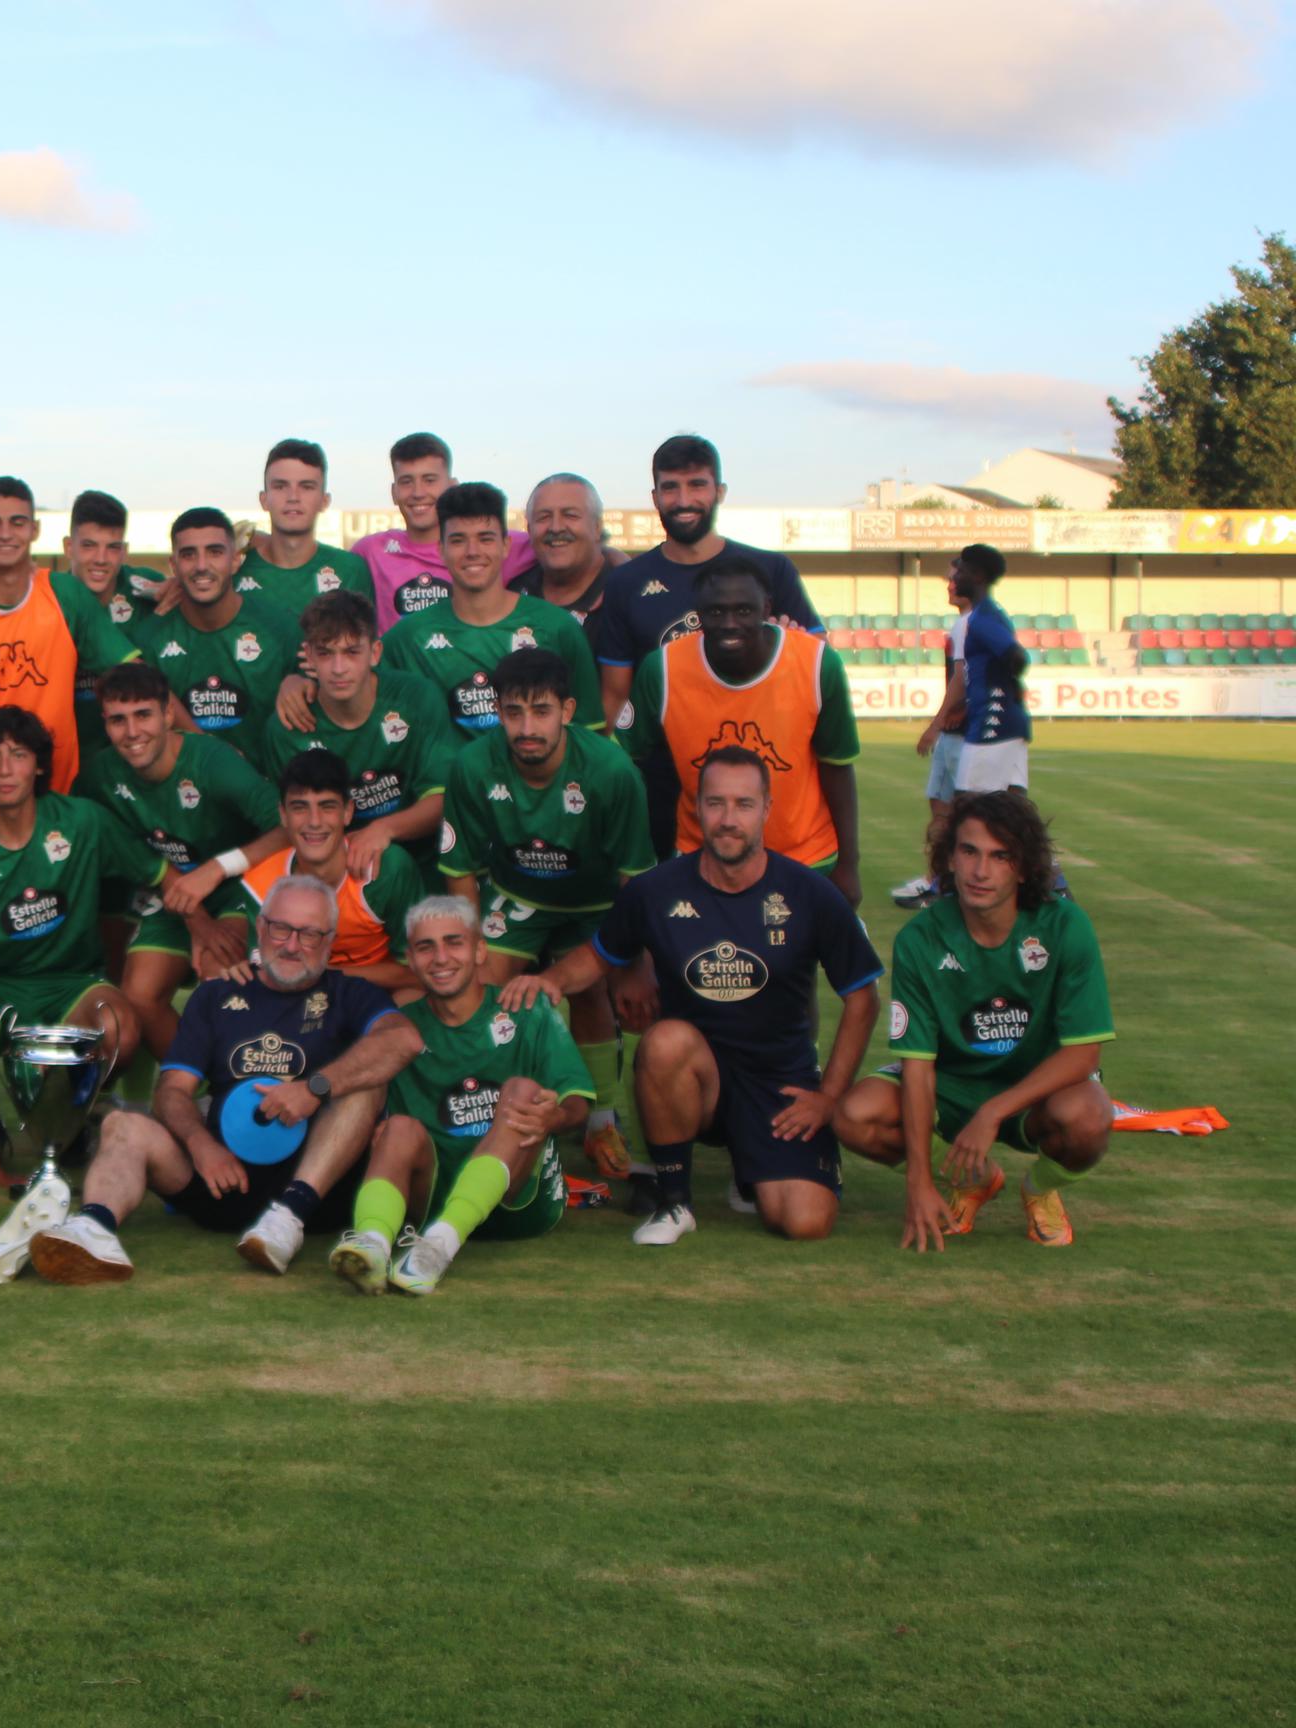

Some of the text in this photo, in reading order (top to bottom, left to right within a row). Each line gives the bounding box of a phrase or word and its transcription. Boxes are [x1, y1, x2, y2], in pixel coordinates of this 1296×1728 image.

[904, 513, 1029, 528] ROVIL STUDIO
[402, 586, 449, 599] Estrella
[190, 688, 238, 703] Estrella
[458, 685, 498, 702] Estrel
[1057, 684, 1180, 709] Pontes
[192, 703, 236, 716] Galicia
[461, 701, 498, 716] Galic
[350, 774, 400, 800] Estrella
[355, 787, 401, 810] Galicia
[515, 848, 569, 861] Estrella
[8, 896, 58, 919] Estrella
[14, 908, 58, 931] Galicia
[699, 960, 754, 974] Estrella
[701, 974, 752, 987] Galicia
[973, 1009, 1029, 1026] Estrella
[977, 1023, 1025, 1040] Galicia
[242, 1047, 293, 1063] Estrella
[242, 1061, 289, 1074] Galicia
[448, 1089, 501, 1111] Estrella
[452, 1104, 496, 1125] Galici
